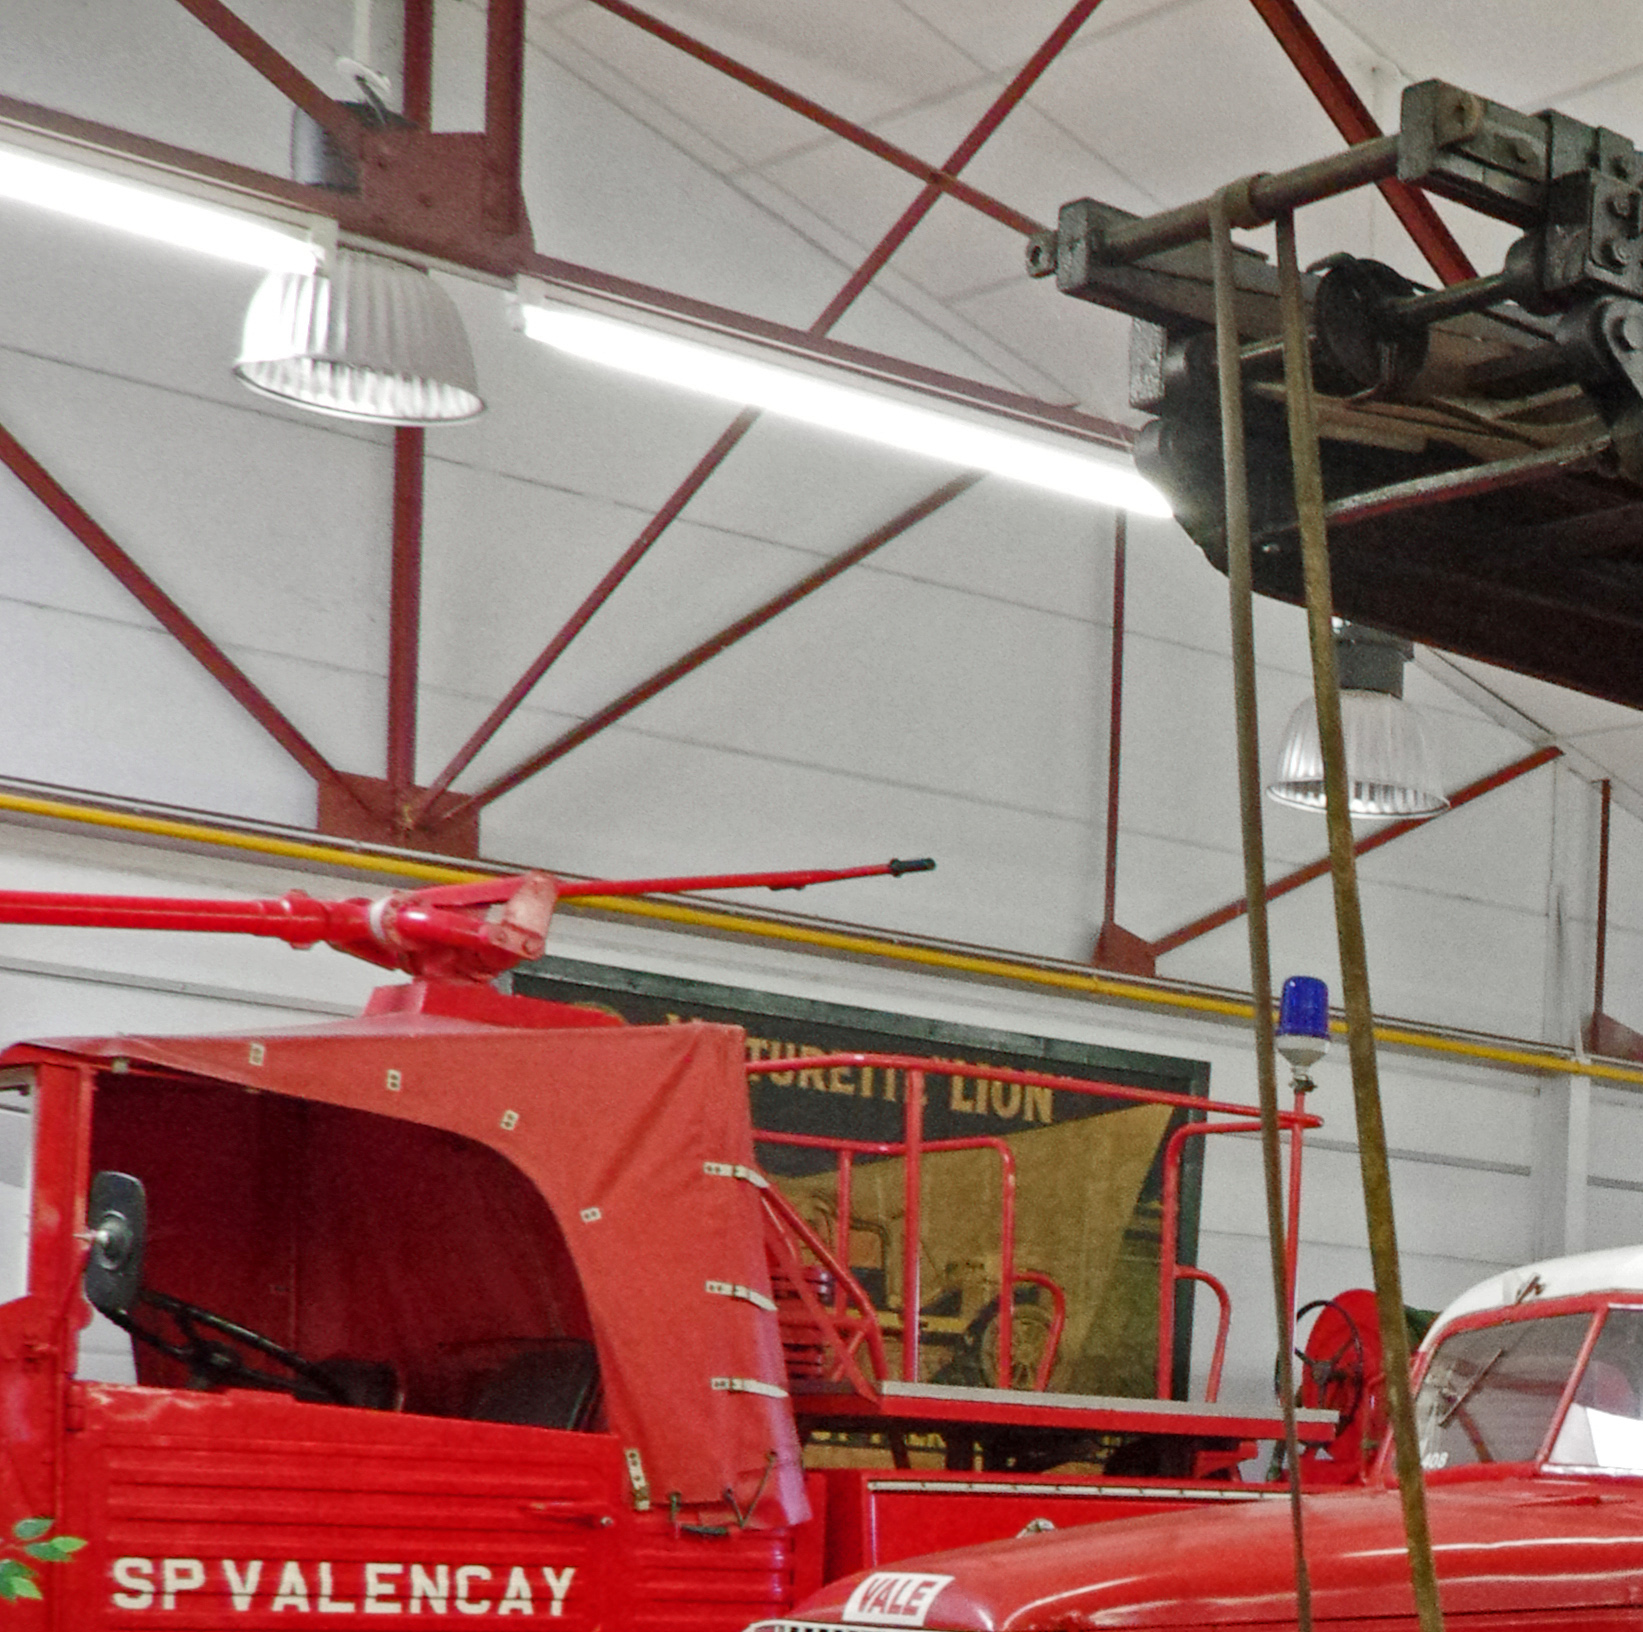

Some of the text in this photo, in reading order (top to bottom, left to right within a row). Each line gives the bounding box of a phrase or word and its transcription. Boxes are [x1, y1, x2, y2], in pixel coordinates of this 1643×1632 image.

[111, 1557, 576, 1617] SP VALENCAY
[857, 1578, 938, 1616] VALE
